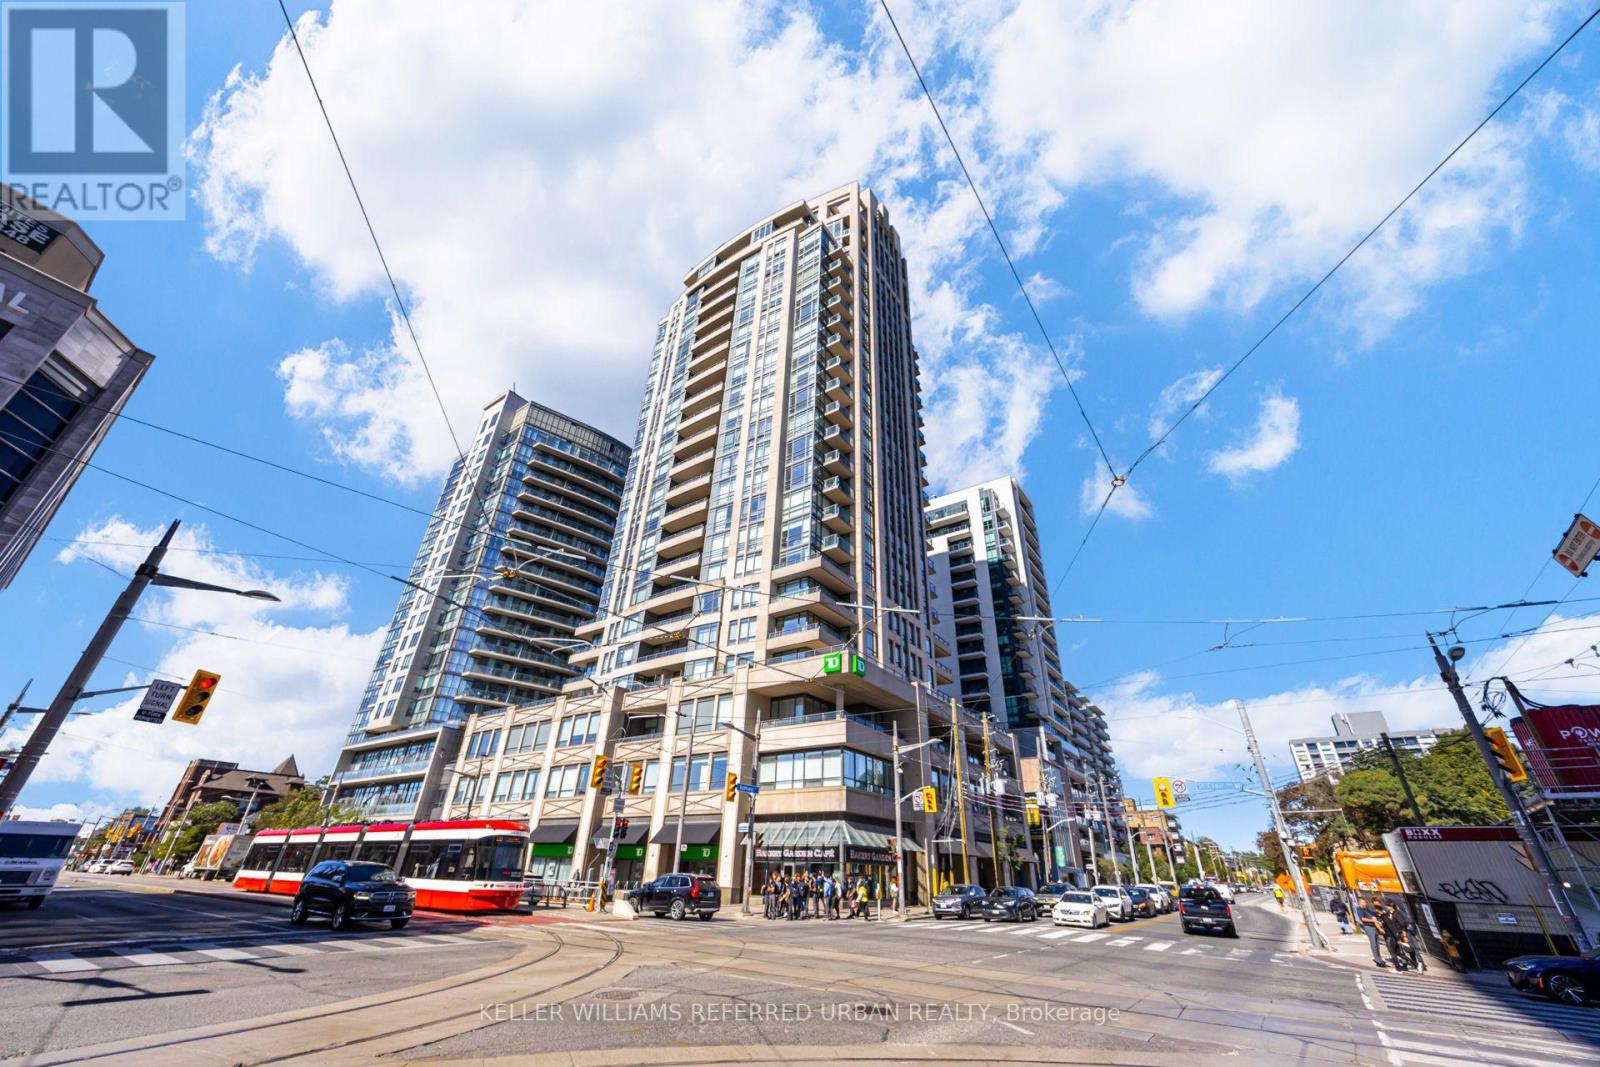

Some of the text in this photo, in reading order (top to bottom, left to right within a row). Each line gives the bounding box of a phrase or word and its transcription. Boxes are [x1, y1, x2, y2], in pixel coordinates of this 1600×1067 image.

[825, 656, 839, 669] TD
[155, 683, 175, 692] LEFT
[151, 691, 172, 700] TURN
[144, 699, 168, 709] SIGNAL
[636, 847, 643, 856] TD
[702, 848, 710, 857] TD
[783, 849, 813, 858] GARDEN
